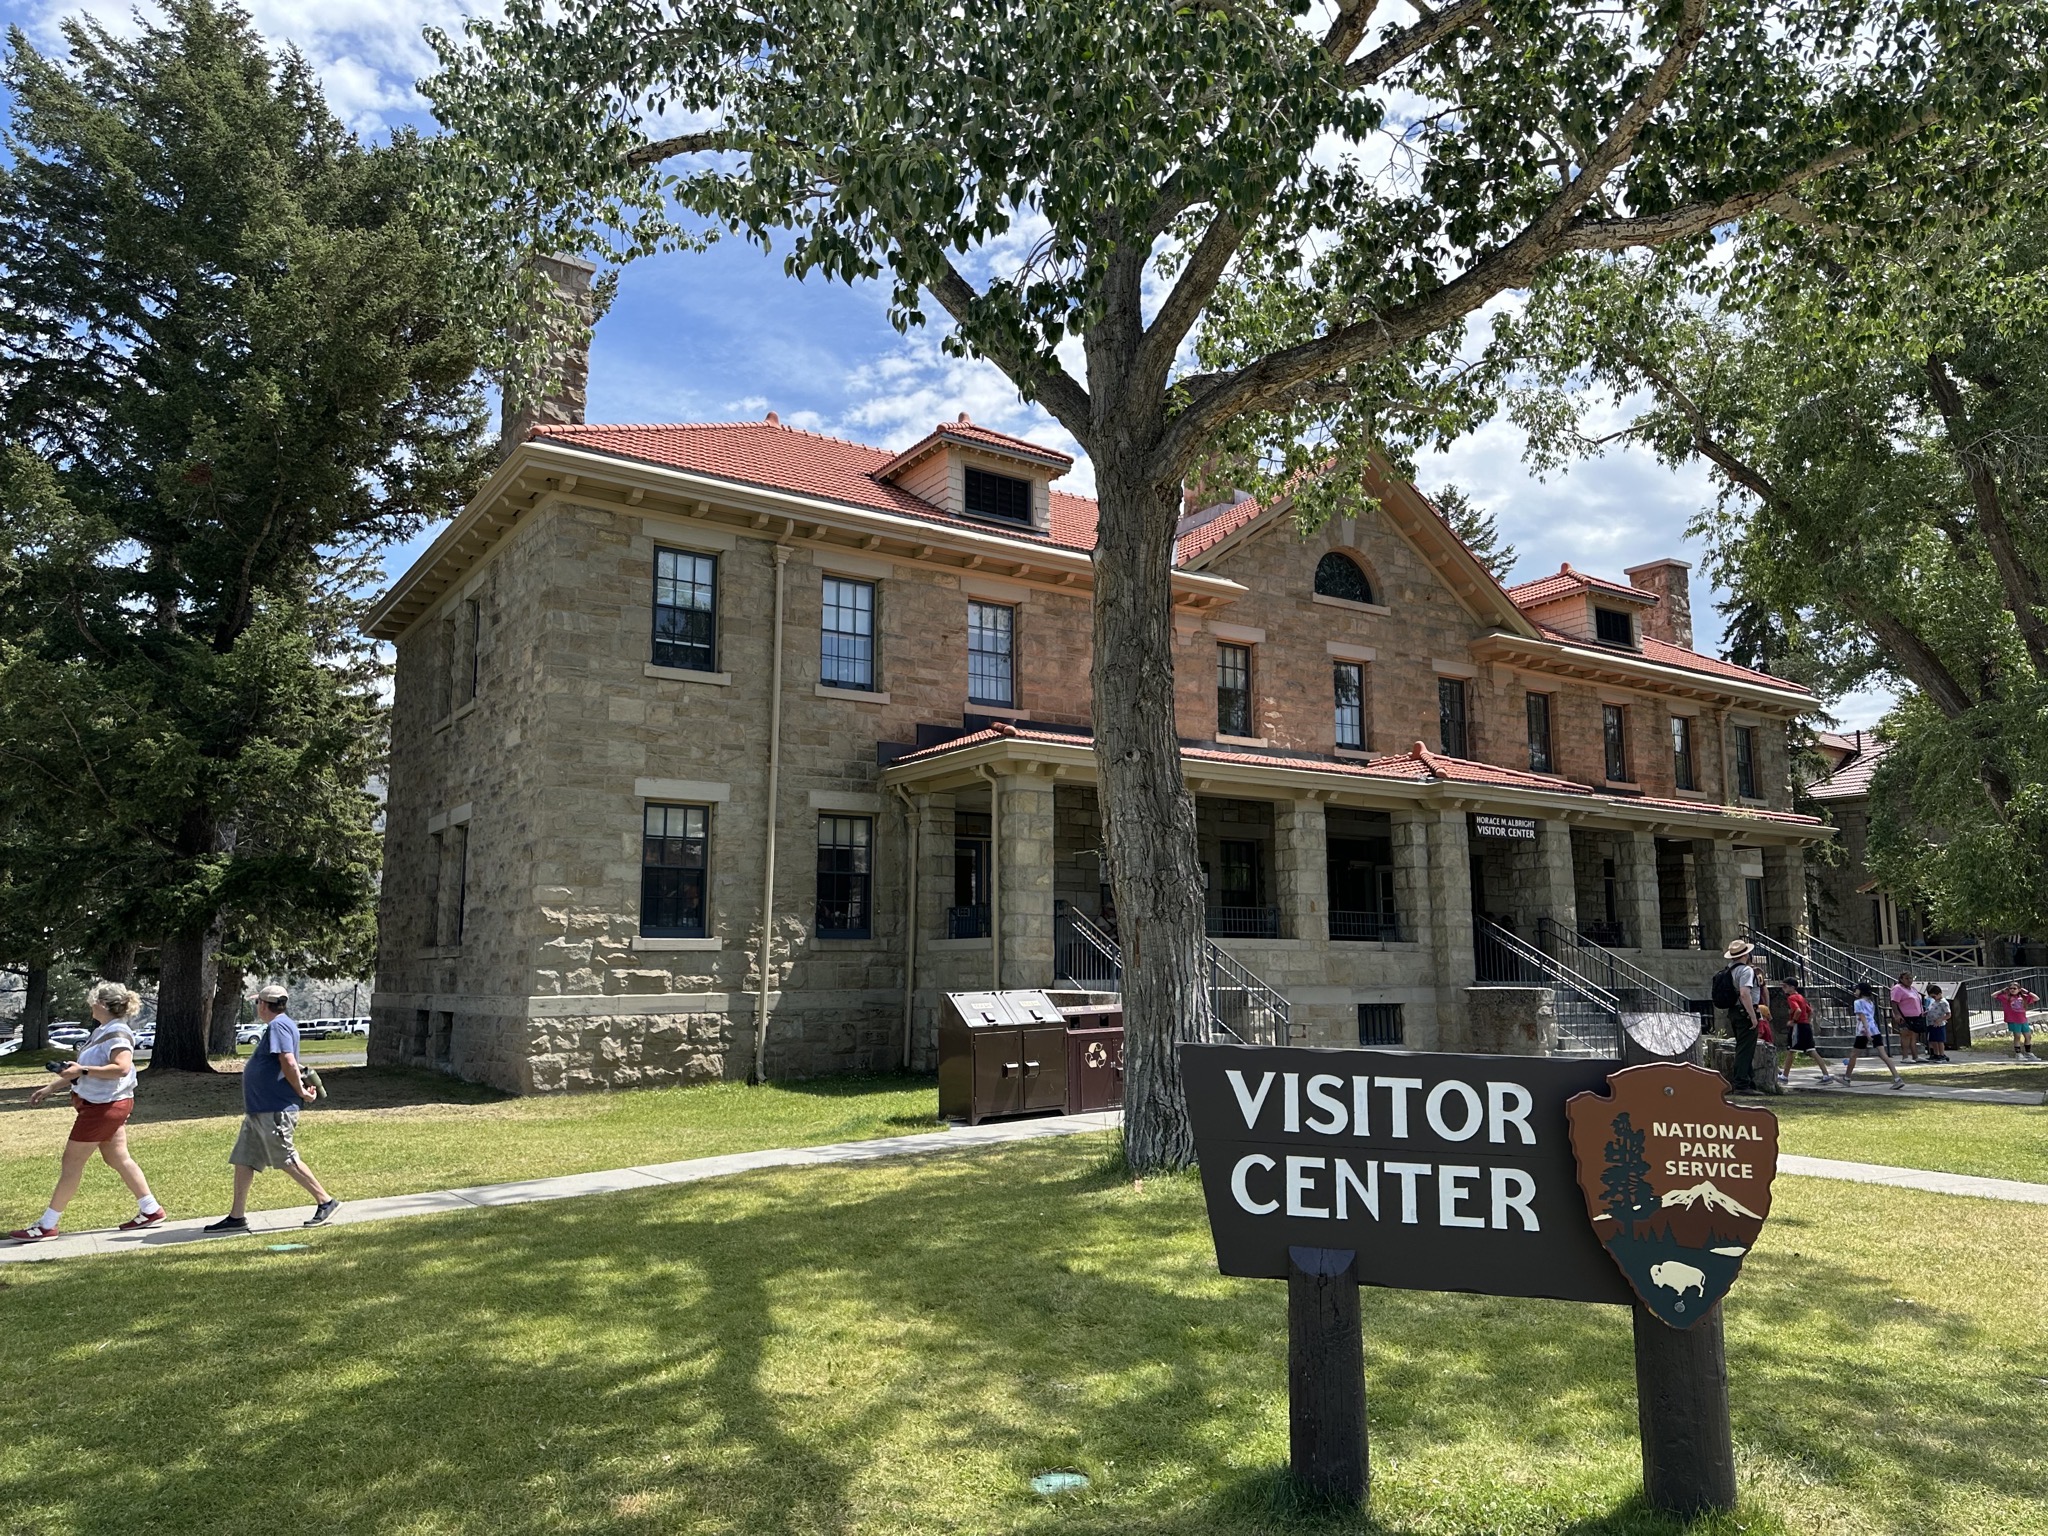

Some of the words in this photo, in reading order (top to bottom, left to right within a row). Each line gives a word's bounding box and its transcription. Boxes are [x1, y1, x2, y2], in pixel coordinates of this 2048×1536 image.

[1476, 816, 1500, 825] HORACE
[1508, 820, 1535, 828] ALBRIGHT
[1477, 826, 1506, 836] VISITOR
[1508, 828, 1535, 839] CENTER
[1225, 1070, 1537, 1144] VISITOR
[1652, 1121, 1763, 1141] NATIONAL
[1679, 1141, 1737, 1159] PARK
[1665, 1160, 1754, 1179] SERVICE
[1230, 1153, 1541, 1232] CENTER
